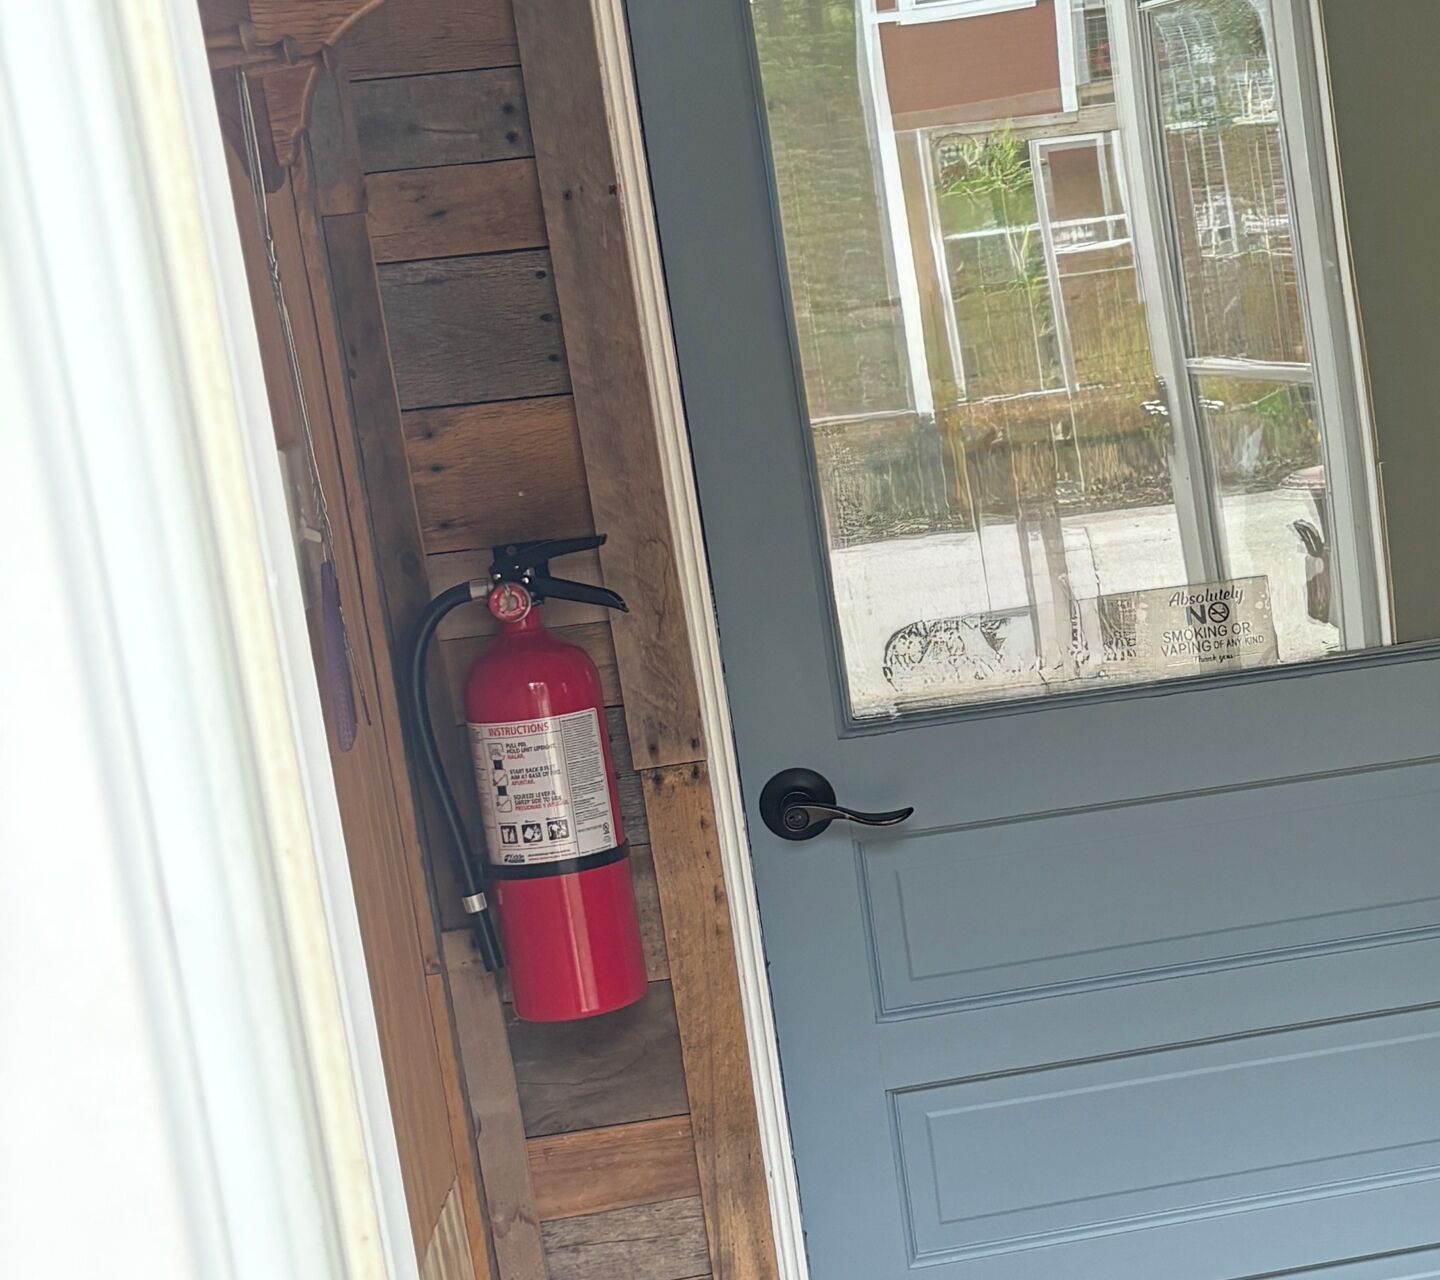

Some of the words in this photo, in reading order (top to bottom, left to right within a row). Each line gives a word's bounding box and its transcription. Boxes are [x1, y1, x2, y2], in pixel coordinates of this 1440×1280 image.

[1169, 585, 1243, 607] Absolutely
[1163, 625, 1227, 643] SMOKING
[1231, 622, 1251, 635] OR
[1161, 640, 1211, 657] VAPING
[1214, 640, 1224, 649] OF
[1227, 638, 1241, 648] ANY
[1245, 635, 1264, 645] KIND
[488, 722, 549, 736] INSTRUCTIONS
